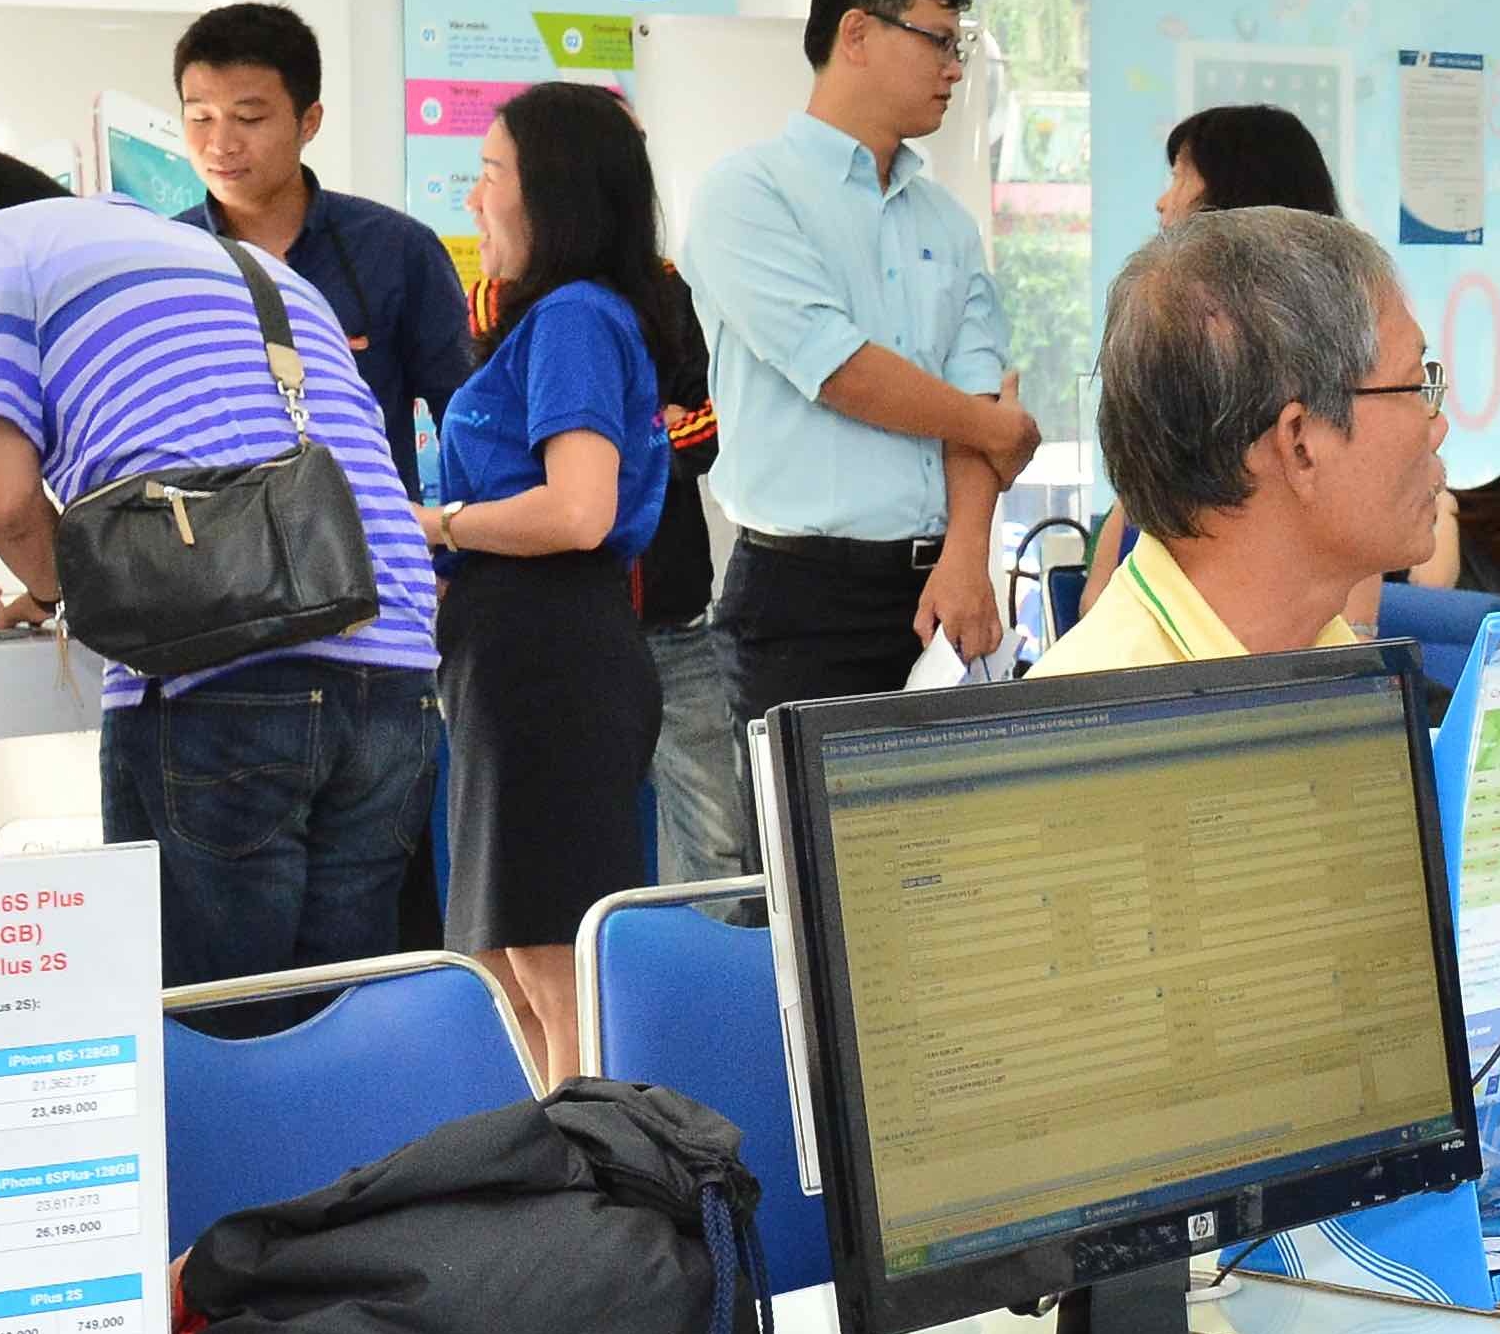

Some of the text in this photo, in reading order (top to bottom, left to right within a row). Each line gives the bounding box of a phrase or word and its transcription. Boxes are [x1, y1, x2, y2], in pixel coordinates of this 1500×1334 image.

[0, 891, 29, 913] 6S
[36, 889, 85, 910] Plus
[38, 951, 68, 972] 2S
[13, 997, 41, 1012] 2S):
[7, 1042, 121, 1067] iPhone 6S-128GB
[30, 1099, 98, 1119] 23,499,000
